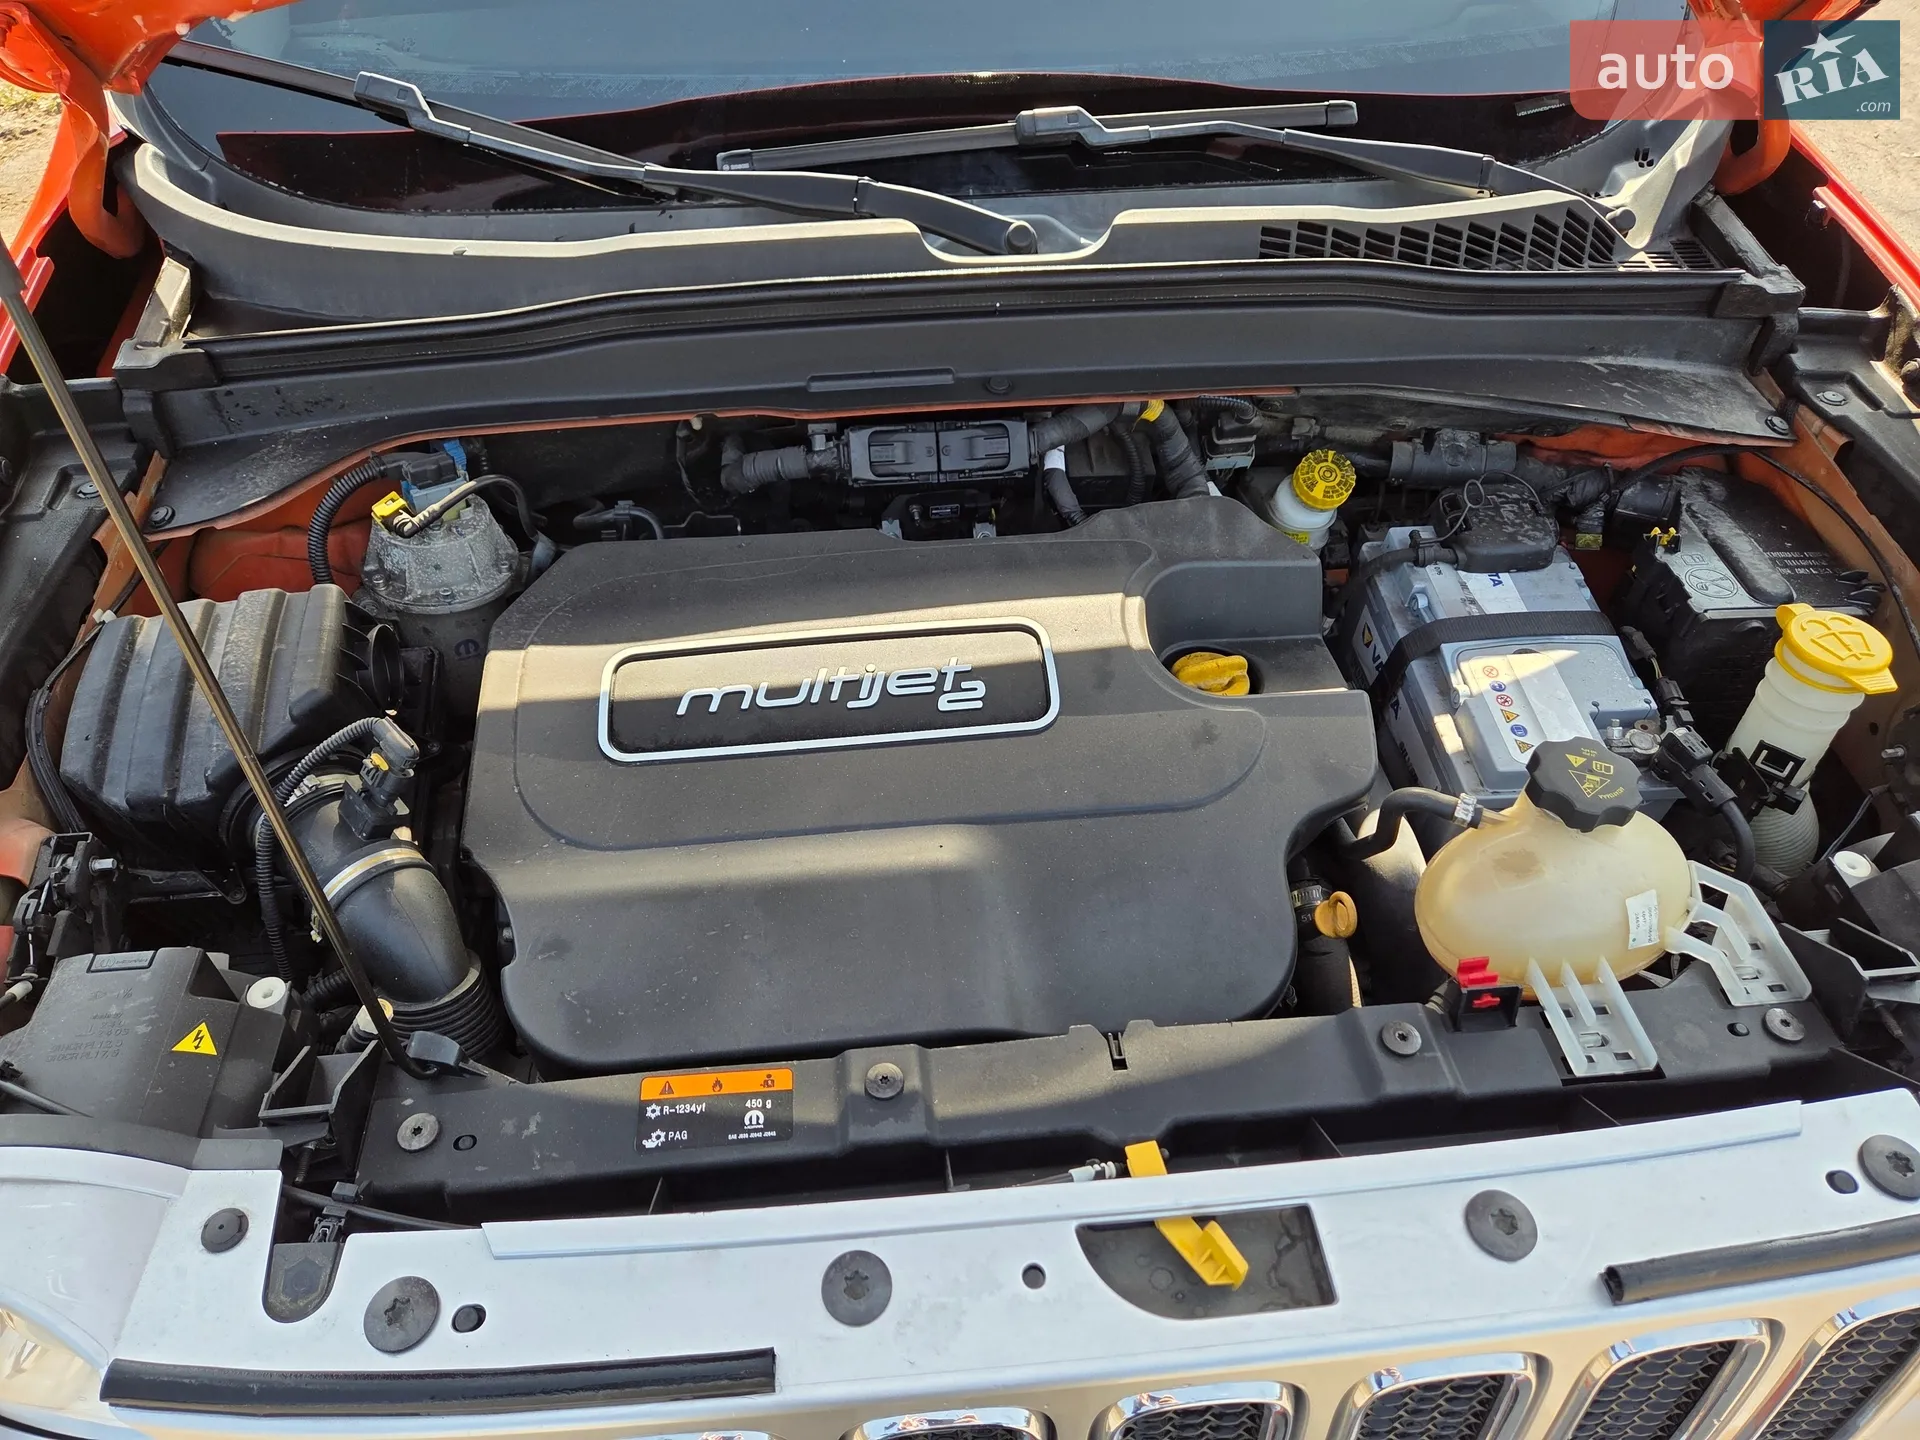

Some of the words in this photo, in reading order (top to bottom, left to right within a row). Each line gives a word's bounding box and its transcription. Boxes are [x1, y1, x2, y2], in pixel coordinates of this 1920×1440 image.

[676, 656, 972, 717] multijet
[937, 679, 985, 713] 2
[662, 1102, 706, 1115] R-1234yf
[745, 1098, 763, 1109] 450
[766, 1099, 772, 1109] g
[668, 1130, 688, 1141] PAG
